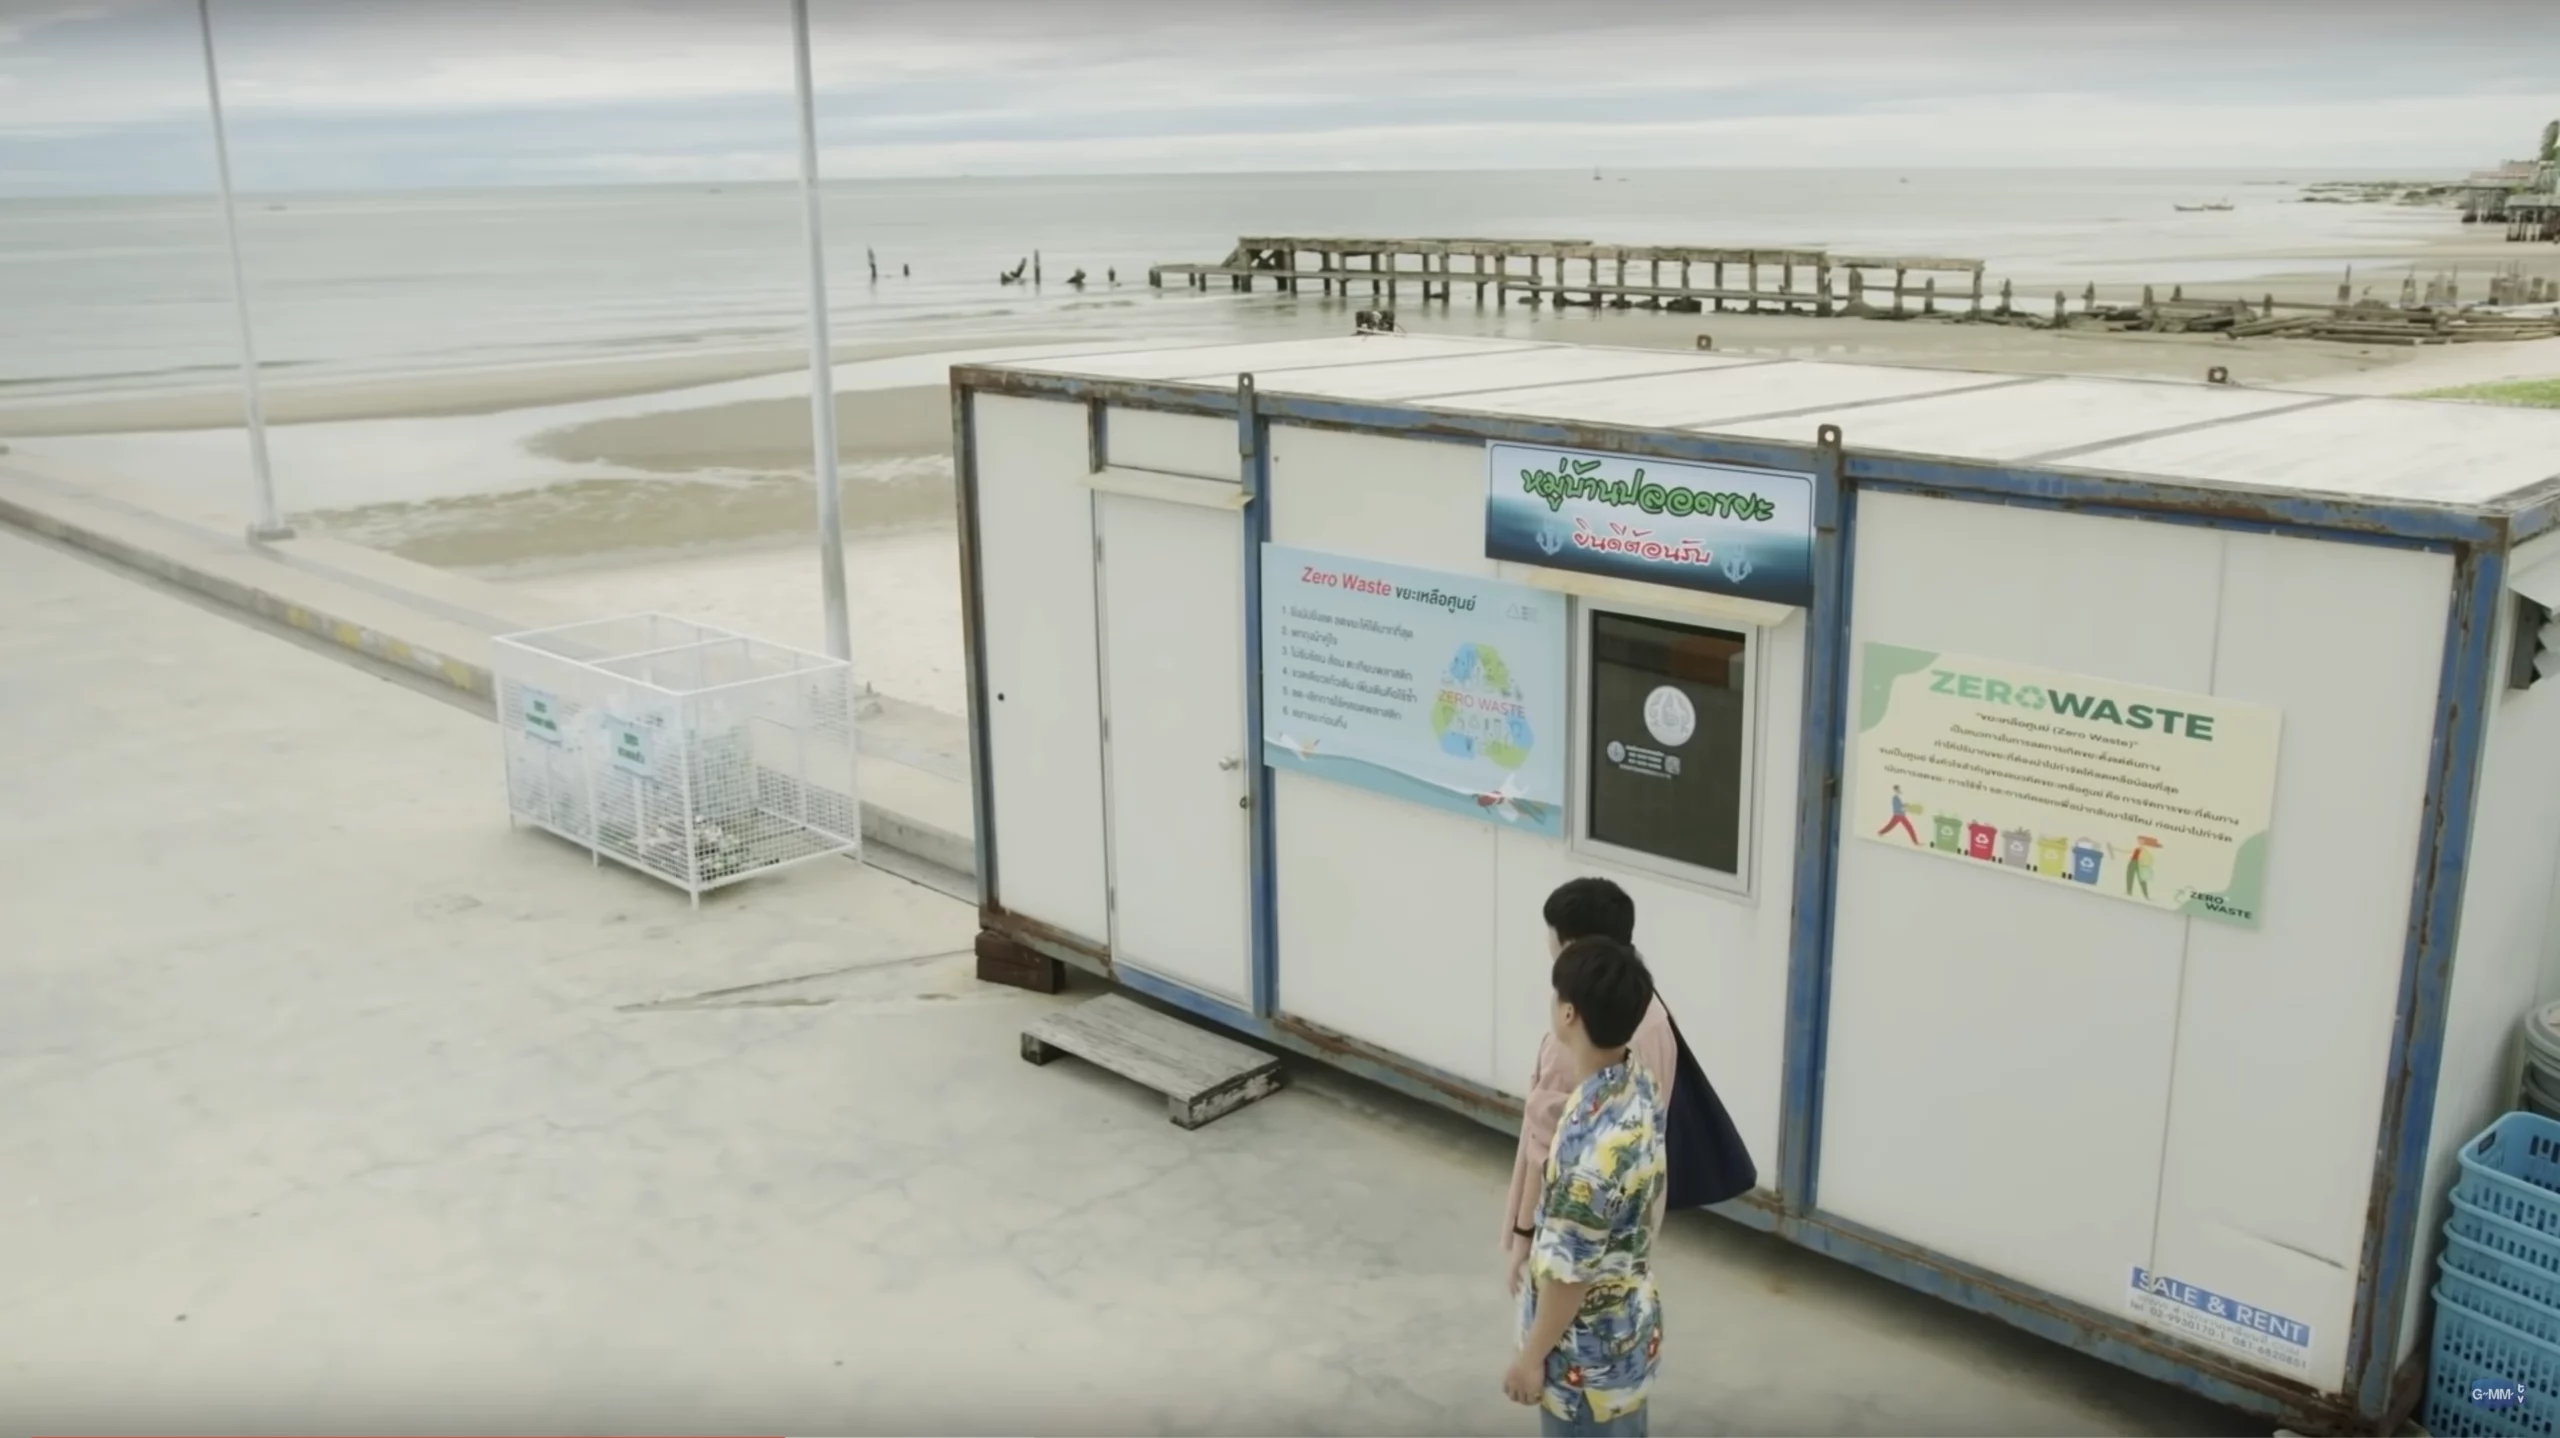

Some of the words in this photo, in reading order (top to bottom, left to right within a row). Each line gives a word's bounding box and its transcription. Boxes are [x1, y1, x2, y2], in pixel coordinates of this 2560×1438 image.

[1521, 457, 1775, 522] หมู่บ้านปลอดขยะ
[1573, 517, 1712, 565] ยินดีต้อนรับ
[1302, 566, 1337, 588] Zero
[1342, 573, 1392, 596] Waste
[1395, 585, 1478, 614] ขยะเหลือศูนย์
[1439, 689, 1475, 708] ZERO
[1478, 698, 1525, 720] WASTE
[2052, 726, 2086, 740] (Zero
[2190, 890, 2224, 905] ZERO
[2205, 902, 2252, 920] WASTE
[2138, 1271, 2198, 1306] SALE
[2207, 1295, 2228, 1317] &
[2236, 1304, 2304, 1343] RENT
